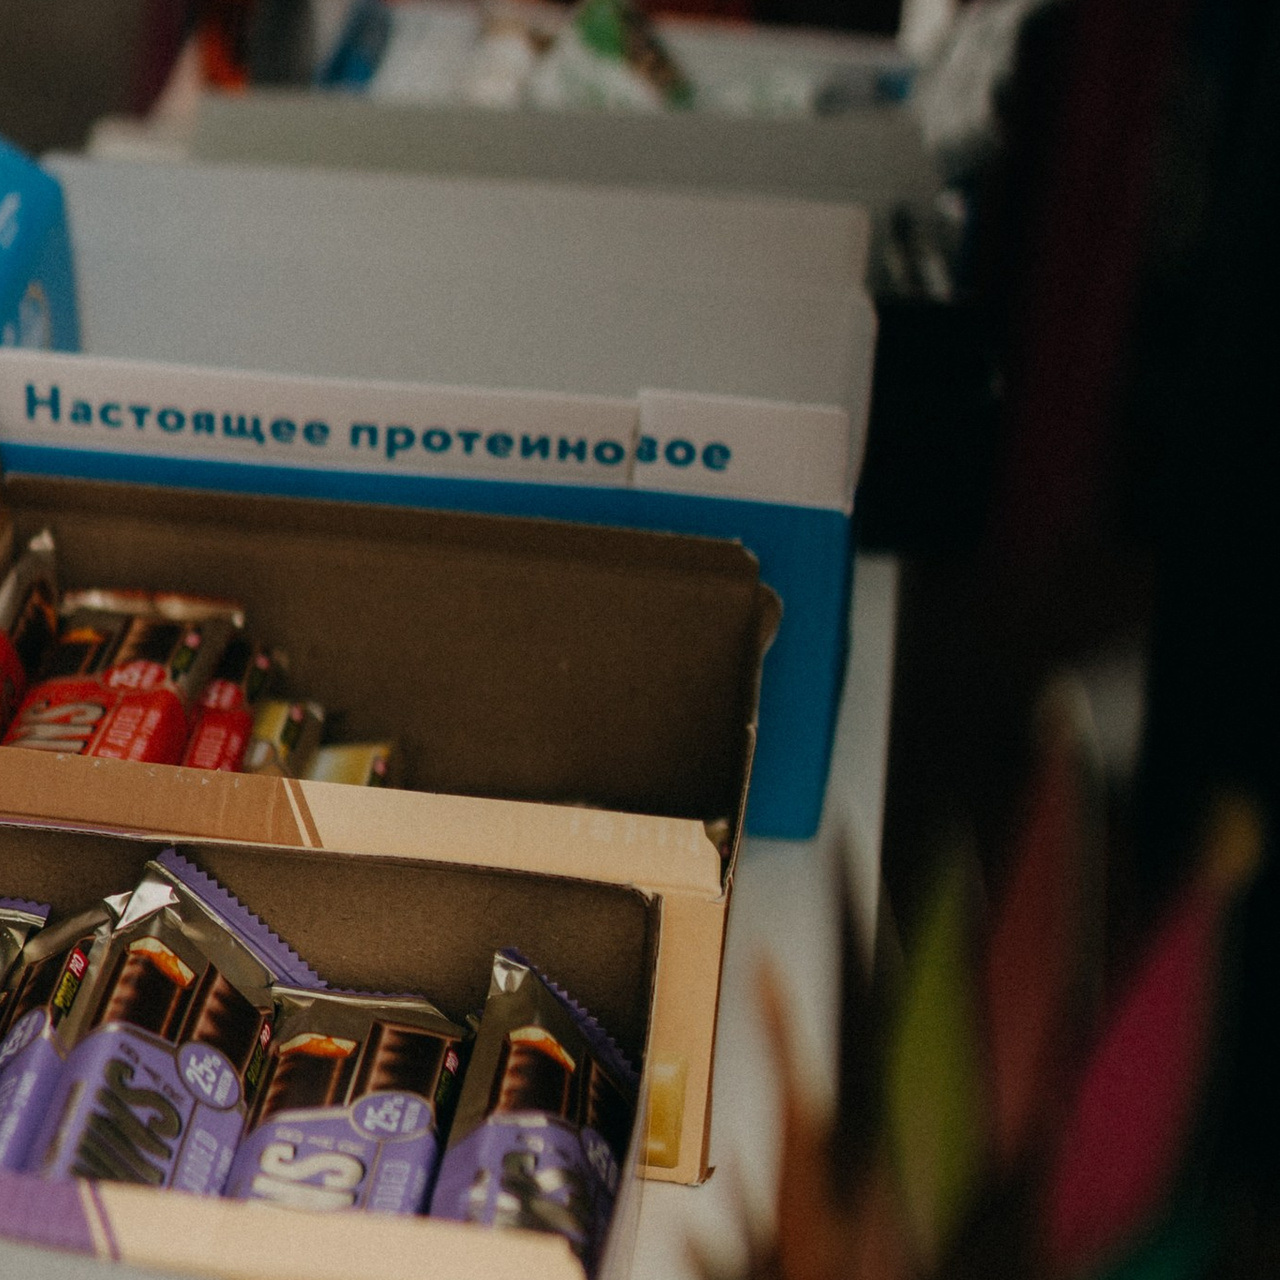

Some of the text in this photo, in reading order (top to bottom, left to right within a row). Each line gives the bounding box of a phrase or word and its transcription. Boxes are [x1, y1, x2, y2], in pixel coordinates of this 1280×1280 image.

[23, 384, 331, 448] Настоящее
[53, 948, 90, 1012] POWER PRO
[184, 1051, 222, 1096] 25%
[362, 1094, 405, 1132] 25%
